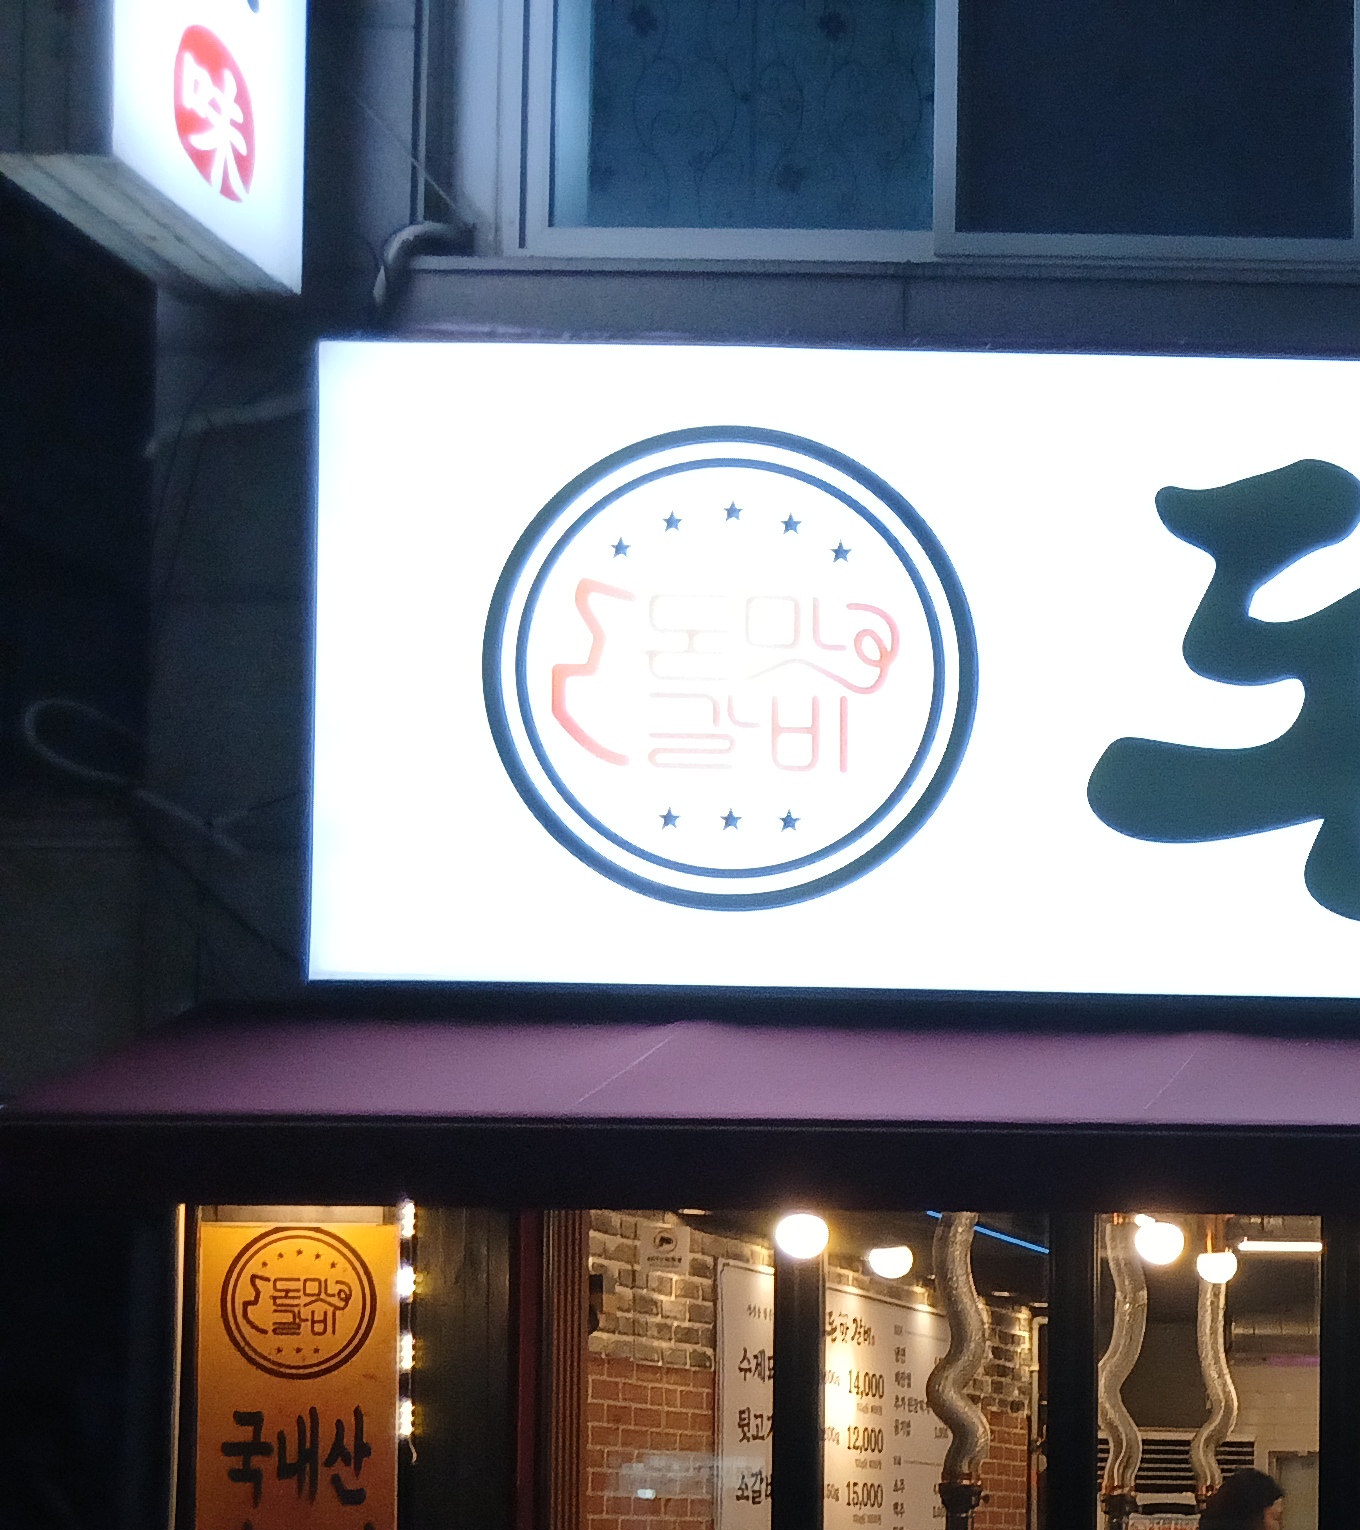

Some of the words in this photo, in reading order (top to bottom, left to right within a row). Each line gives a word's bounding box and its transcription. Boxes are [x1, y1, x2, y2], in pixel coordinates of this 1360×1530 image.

[180, 50, 250, 200] 味
[640, 594, 862, 690] 돈맛
[649, 696, 848, 773] 갈비
[848, 1370, 885, 1399] 14,000
[221, 1405, 371, 1507] 국내산
[847, 1425, 885, 1454] 12,000
[846, 1481, 884, 1509] 15,000
